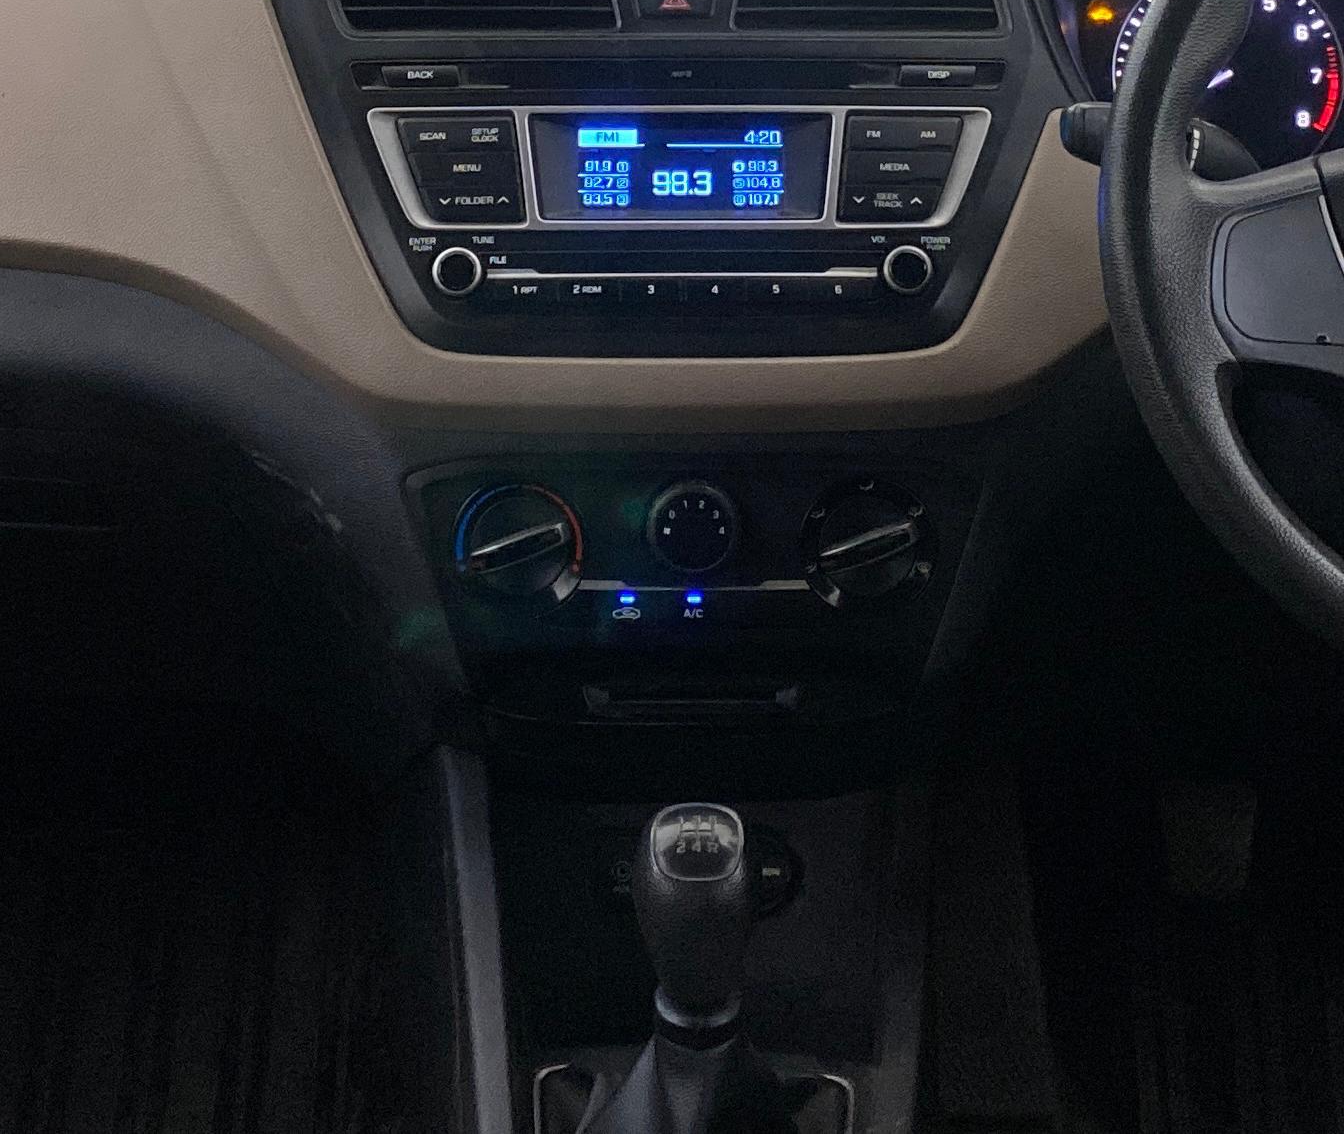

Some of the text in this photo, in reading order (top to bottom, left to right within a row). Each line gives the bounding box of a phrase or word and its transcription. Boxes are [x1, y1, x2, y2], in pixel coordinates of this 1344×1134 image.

[1295, 23, 1309, 41] 6
[407, 70, 433, 79] BACK
[927, 70, 950, 79] DISP
[1310, 67, 1322, 84] 7
[1295, 110, 1310, 128] 8
[419, 132, 446, 141] SCAN
[596, 132, 619, 143] FM1
[744, 130, 781, 144] 4:20
[866, 130, 881, 138] FM
[920, 130, 936, 138] AM
[471, 135, 499, 143] CLOCK
[453, 164, 481, 172] MENU
[879, 163, 910, 171] MEDIA
[652, 170, 712, 196] 98.3
[455, 196, 494, 205] FOLDER
[873, 200, 903, 208] TRACK
[409, 237, 436, 245] ENTER
[472, 236, 494, 244] TUNE
[921, 236, 951, 244] POWER
[489, 256, 507, 264] FILE
[512, 285, 518, 294] 1
[573, 285, 580, 294] 2
[648, 285, 654, 294] 3
[711, 285, 719, 294] 4
[772, 284, 780, 294] 5
[834, 285, 842, 294] 6
[683, 609, 704, 618] A/C
